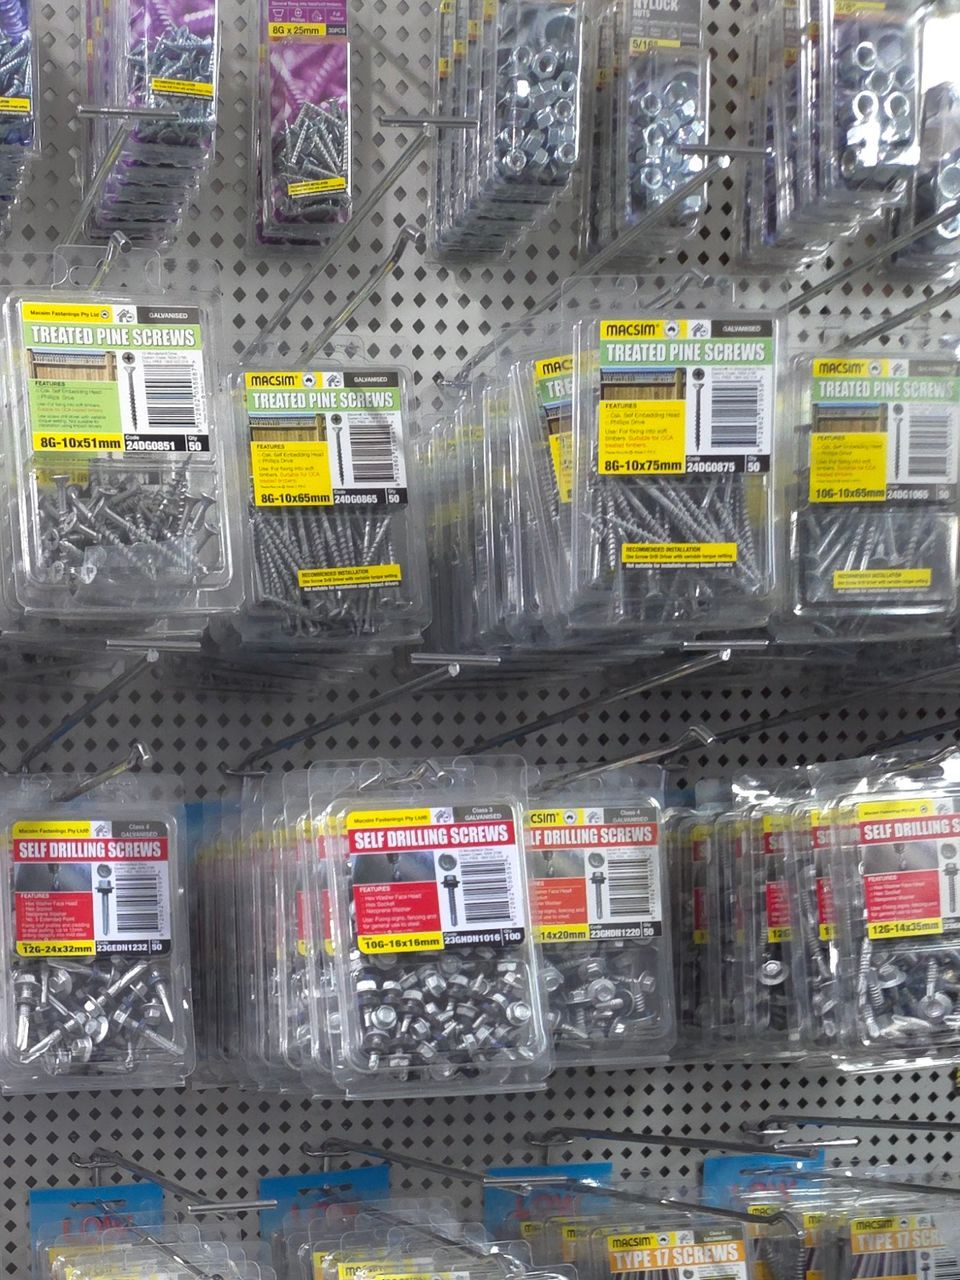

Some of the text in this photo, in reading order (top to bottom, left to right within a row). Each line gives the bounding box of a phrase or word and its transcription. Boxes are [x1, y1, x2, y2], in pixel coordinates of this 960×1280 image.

[606, 324, 655, 336] MACSIM
[32, 326, 195, 347] TREATED PINE SCREWS
[607, 343, 764, 361] TREATED PINE SCREWS
[819, 363, 861, 374] MACSIM
[251, 375, 295, 386] MACSIM
[819, 381, 953, 398] TREATED PINE SCREWS
[253, 392, 393, 408] TREATED PINE SCREWS
[40, 438, 121, 448] 8G-10x51mm
[605, 460, 682, 471] 8G-10x75mm
[747, 462, 760, 472] 50
[261, 494, 330, 503] 8G-10x65mm
[389, 495, 399, 504] 50
[544, 825, 652, 844] DRILLING SCREWS
[864, 819, 950, 840] SELF DRILLING
[354, 824, 508, 849] SELF DRILLING SCREWS
[19, 842, 161, 858] SELF DRILLING SCREWS
[504, 932, 521, 941] 100
[612, 1236, 652, 1247] MACSIM
[614, 1244, 738, 1269] TYPE 17 SCREWS
